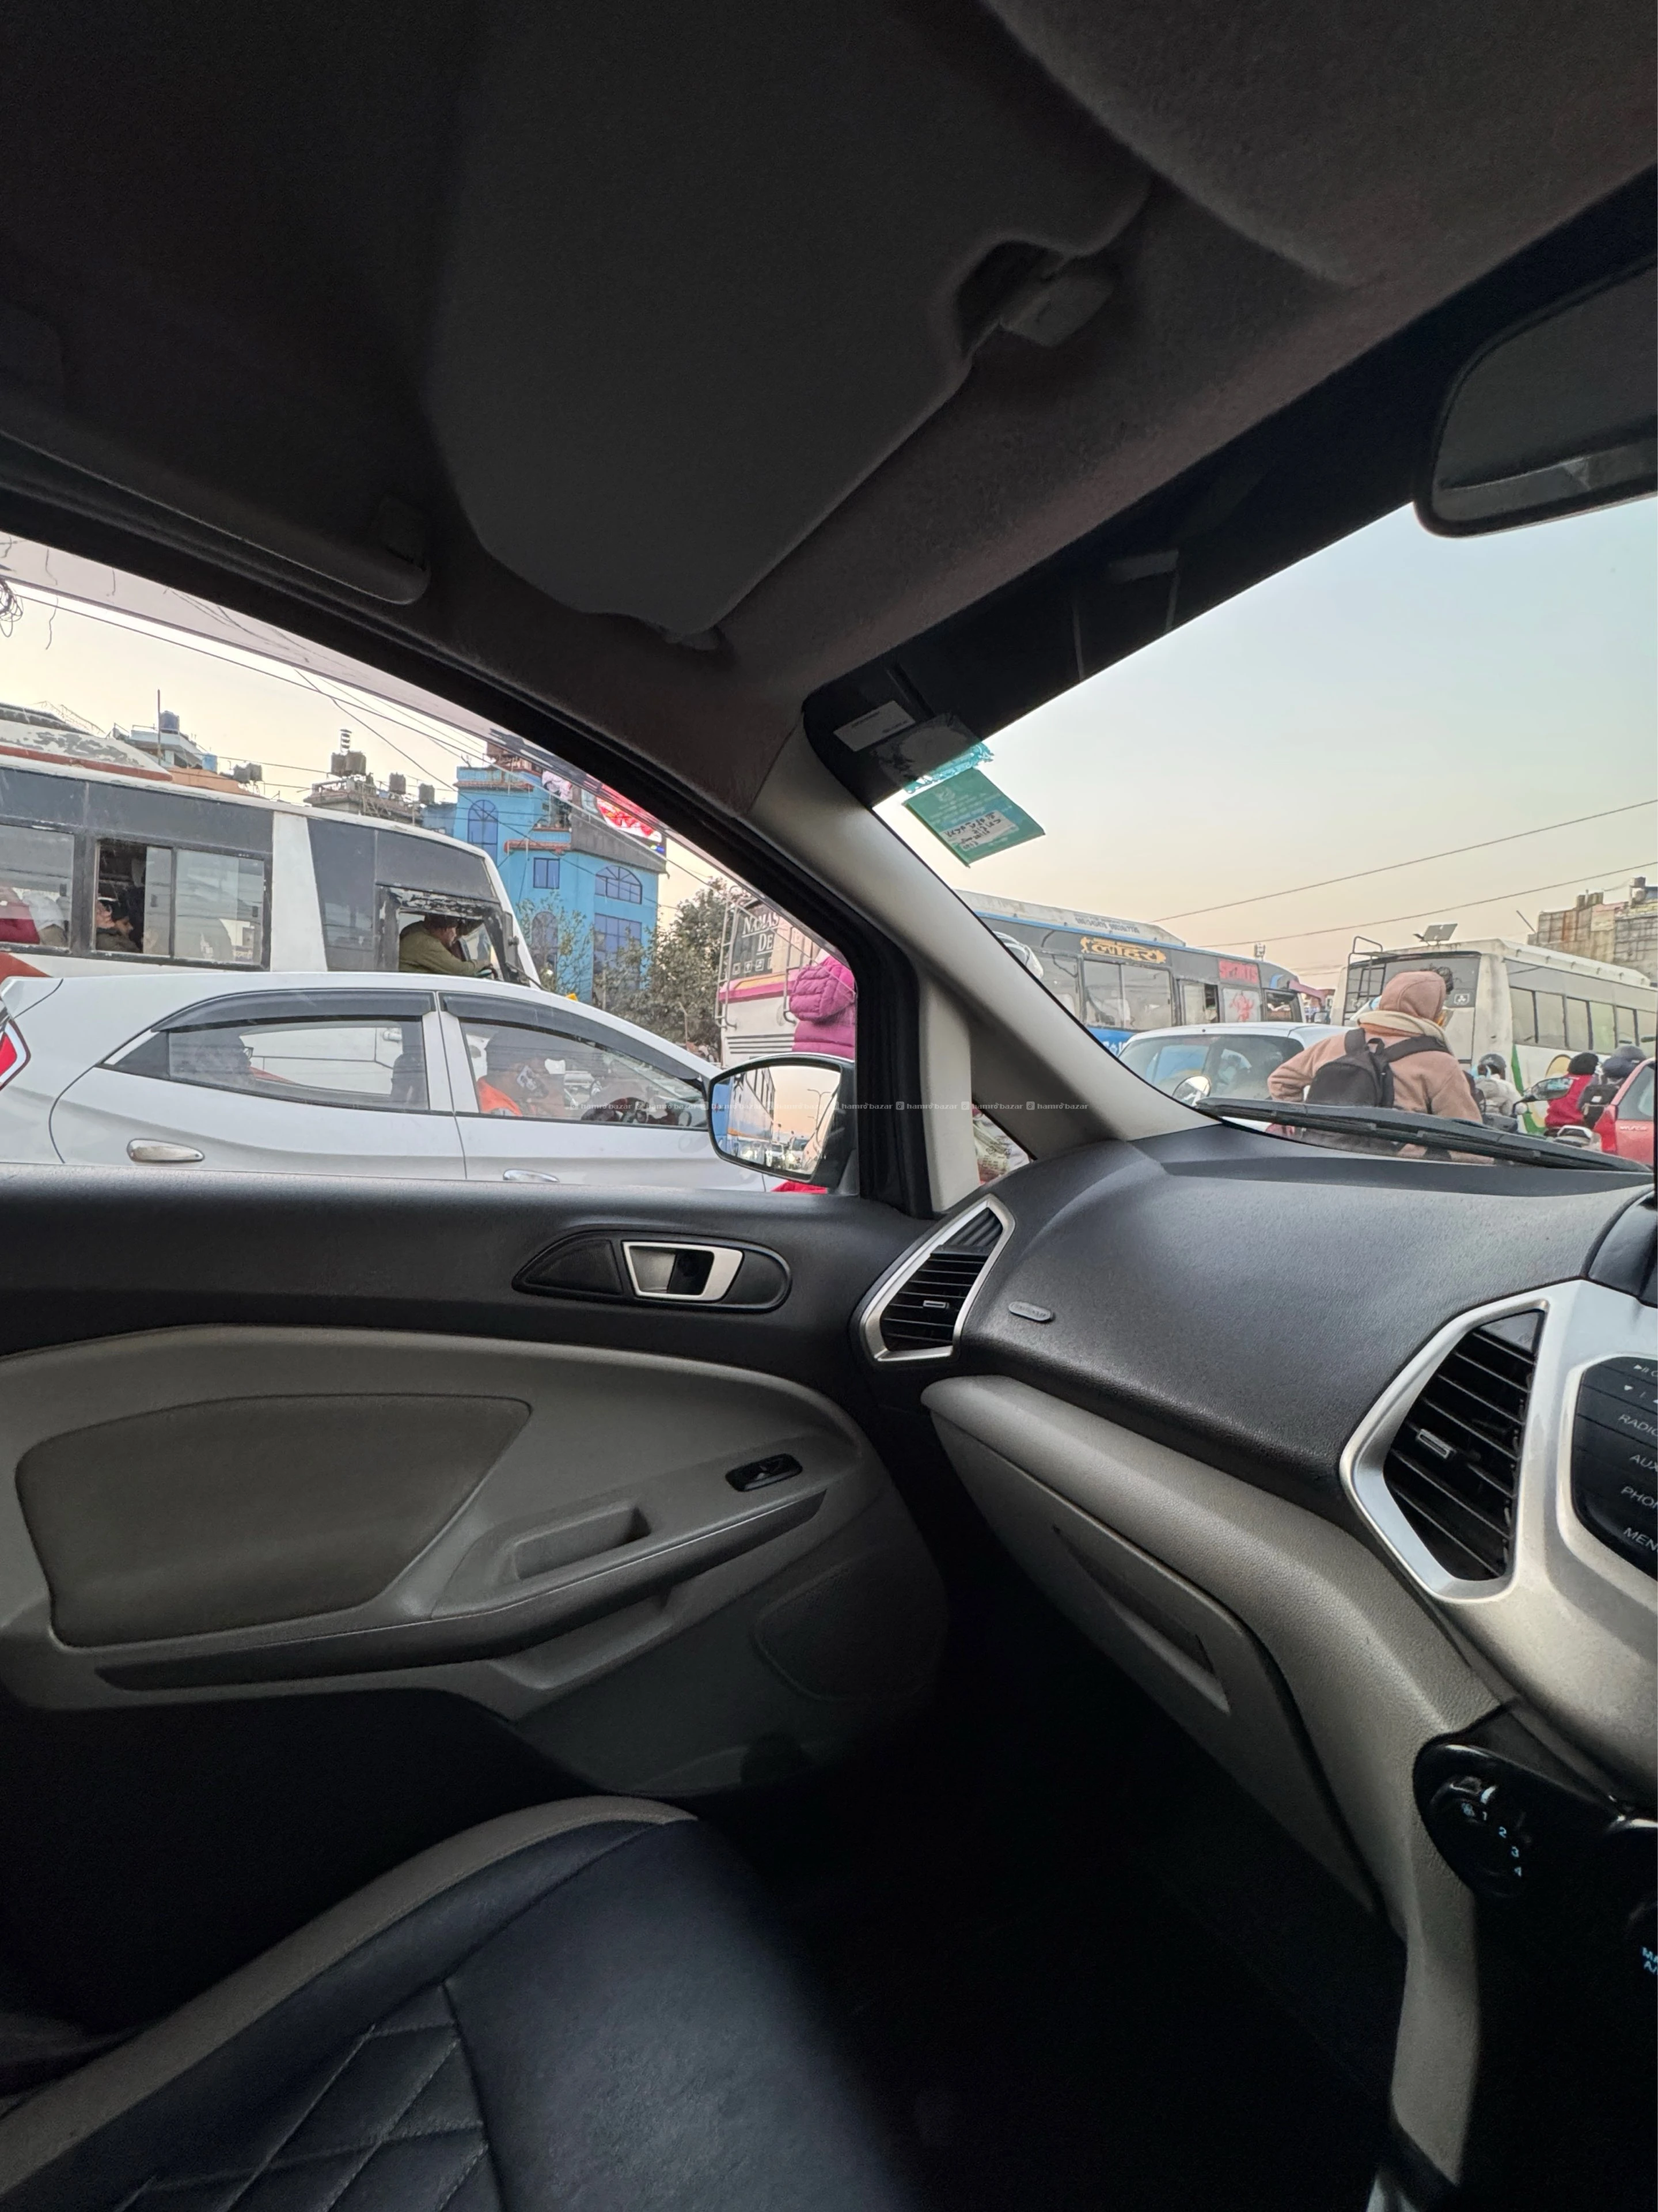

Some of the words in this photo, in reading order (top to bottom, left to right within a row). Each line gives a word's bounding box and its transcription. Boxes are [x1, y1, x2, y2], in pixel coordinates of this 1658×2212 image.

[1623, 1527, 1657, 1552] MEN
[1498, 1825, 1507, 1838] 2
[1511, 1846, 1520, 1858] 3
